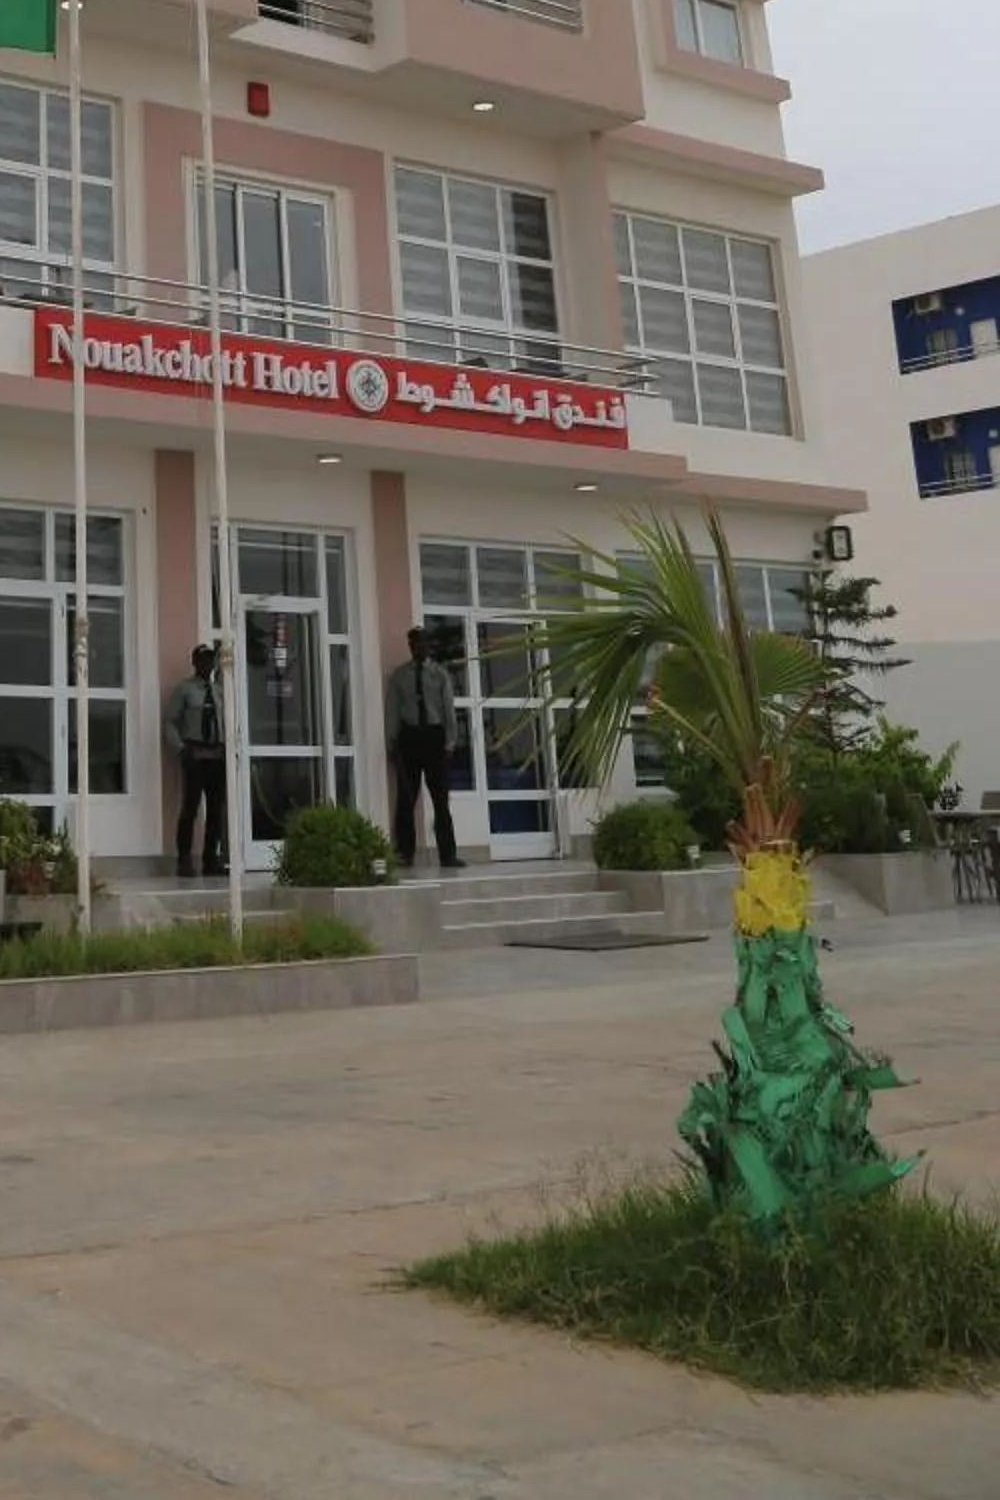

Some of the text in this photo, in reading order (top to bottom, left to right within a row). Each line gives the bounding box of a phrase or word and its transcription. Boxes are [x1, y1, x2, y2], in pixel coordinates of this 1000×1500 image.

[47, 323, 340, 399] Nouakchott Hotel
[552, 393, 626, 431] فندق
